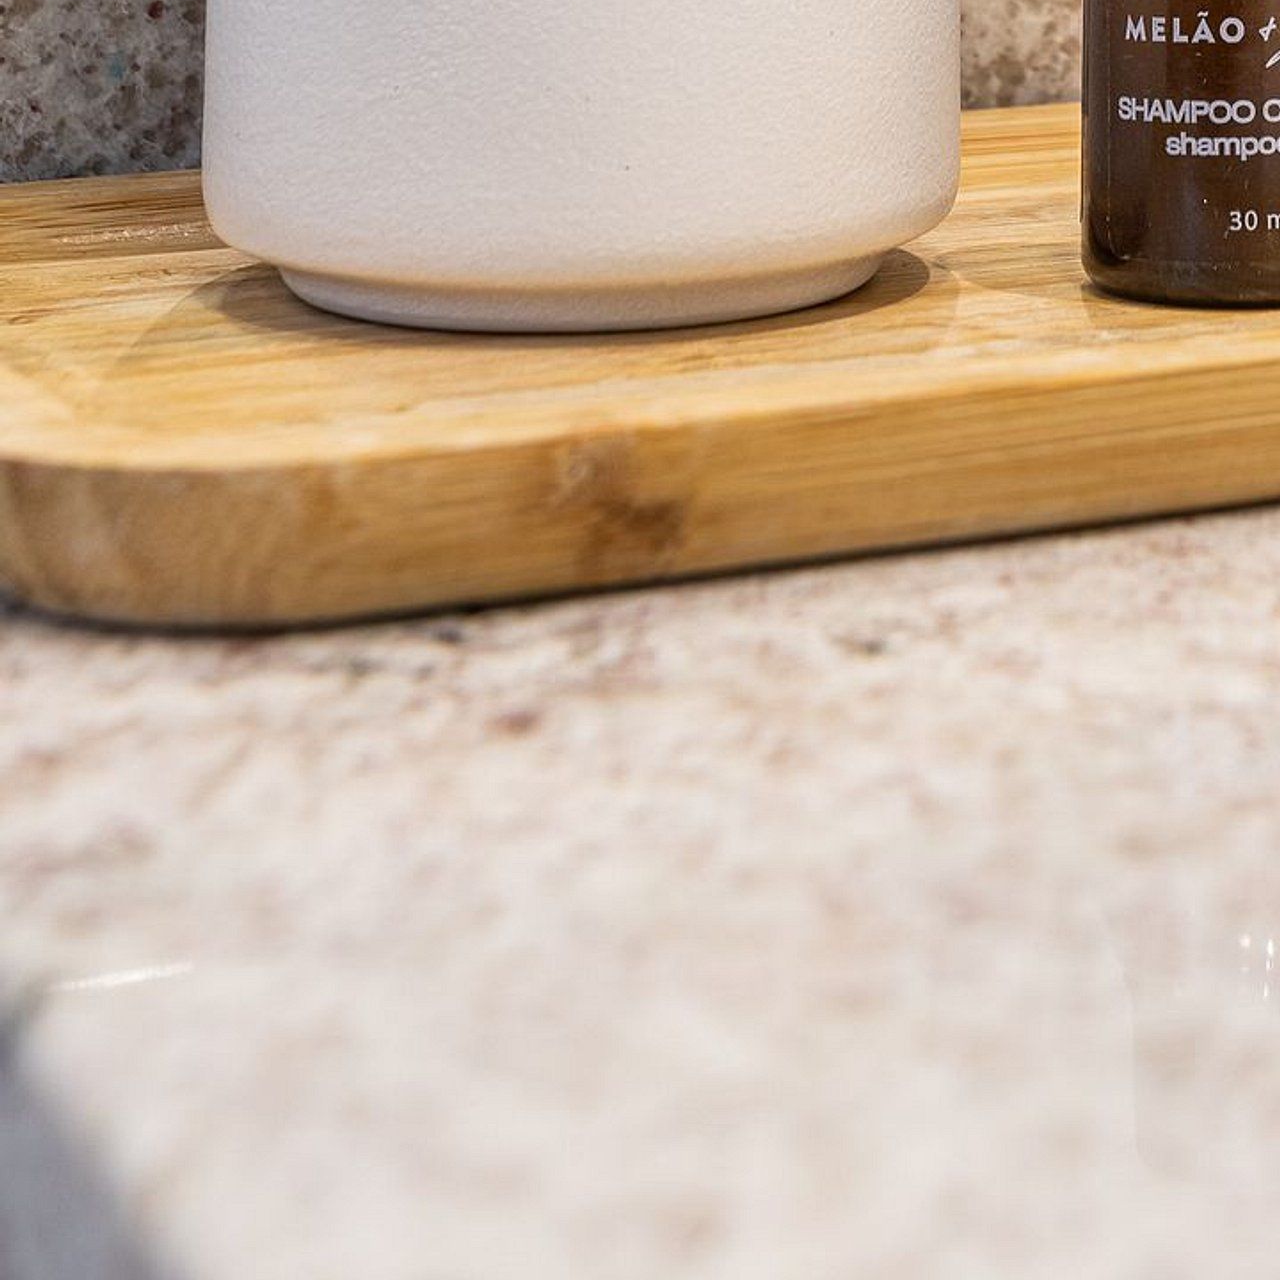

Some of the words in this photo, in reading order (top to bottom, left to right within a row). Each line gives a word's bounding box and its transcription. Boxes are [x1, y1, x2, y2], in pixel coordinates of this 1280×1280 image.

[1124, 11, 1246, 44] MELÃO
[1117, 96, 1256, 125] SHAMPOO
[1229, 210, 1259, 231] 30
